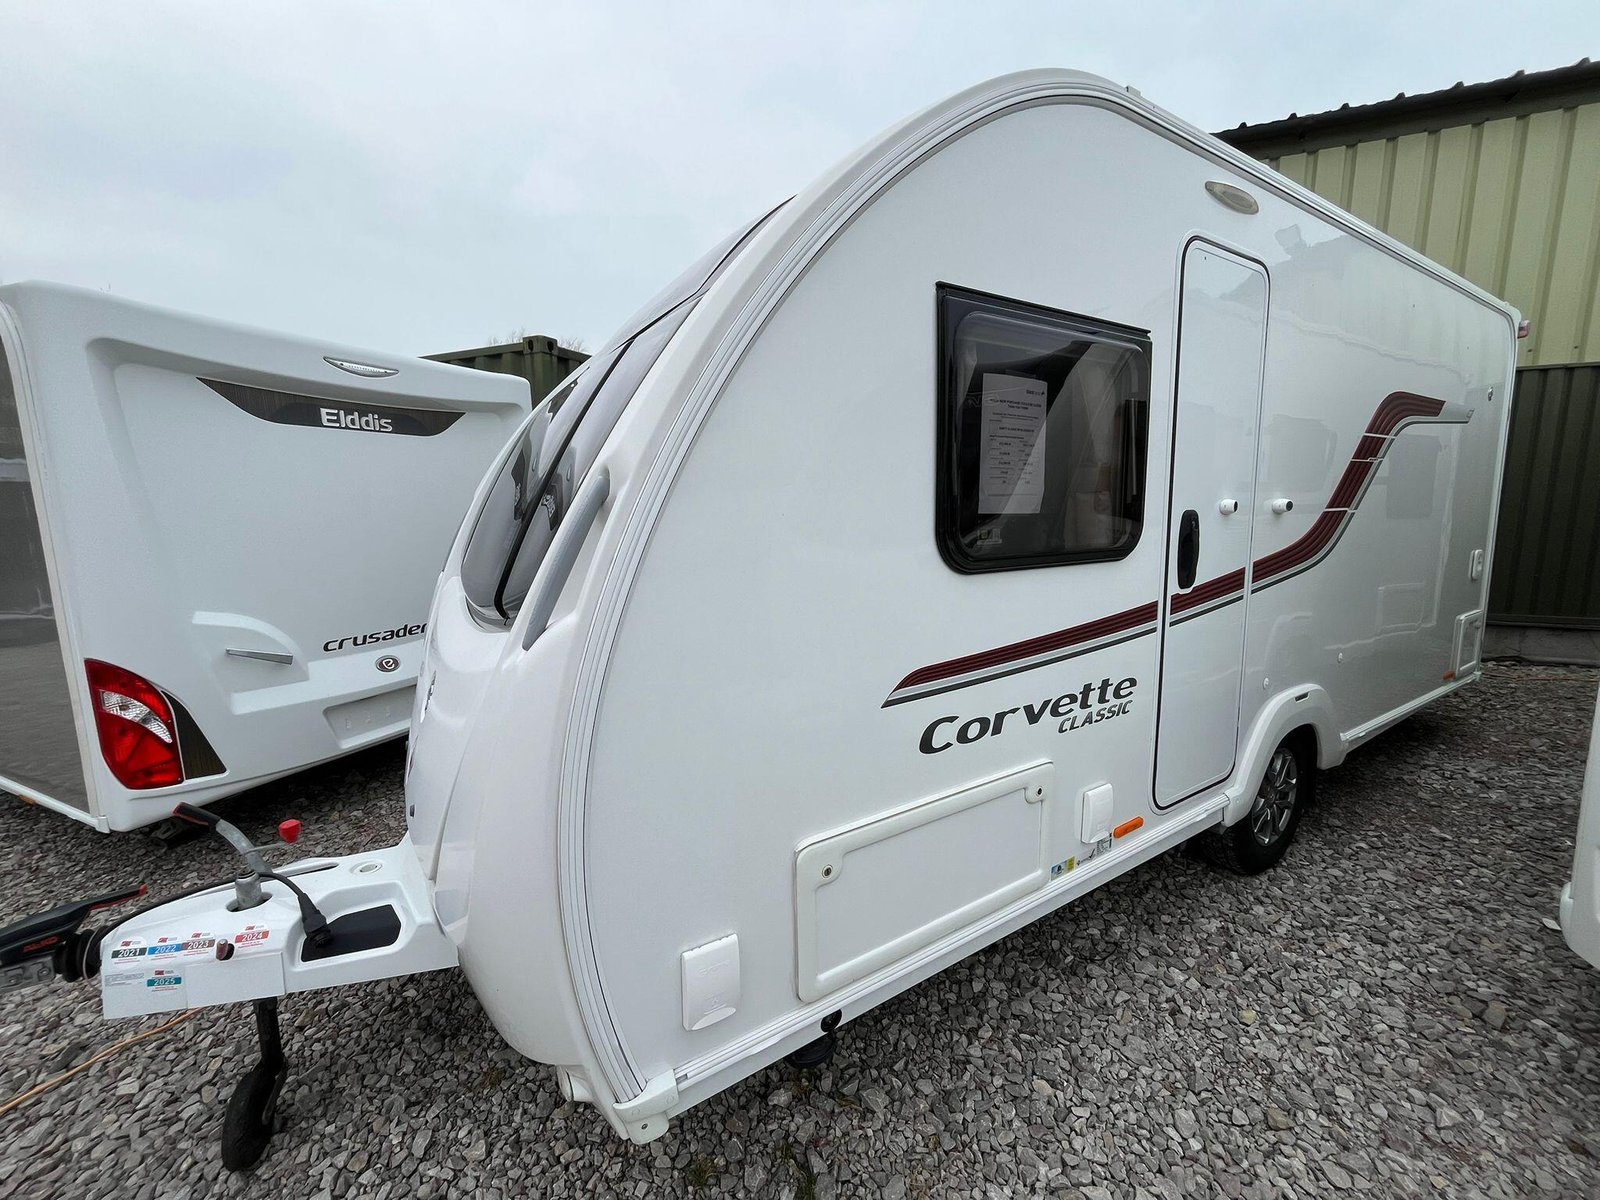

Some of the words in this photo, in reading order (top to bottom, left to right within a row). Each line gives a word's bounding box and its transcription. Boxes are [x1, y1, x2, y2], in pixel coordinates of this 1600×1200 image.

[320, 407, 393, 432] Elddis
[323, 622, 427, 652] crusader
[918, 676, 1138, 755] Corvette
[1057, 699, 1133, 734] CLASSIC
[241, 931, 263, 942] 2024
[154, 944, 177, 954] 2022
[187, 940, 209, 950] 2023
[117, 947, 140, 958] 2021
[153, 977, 176, 986] 2025
